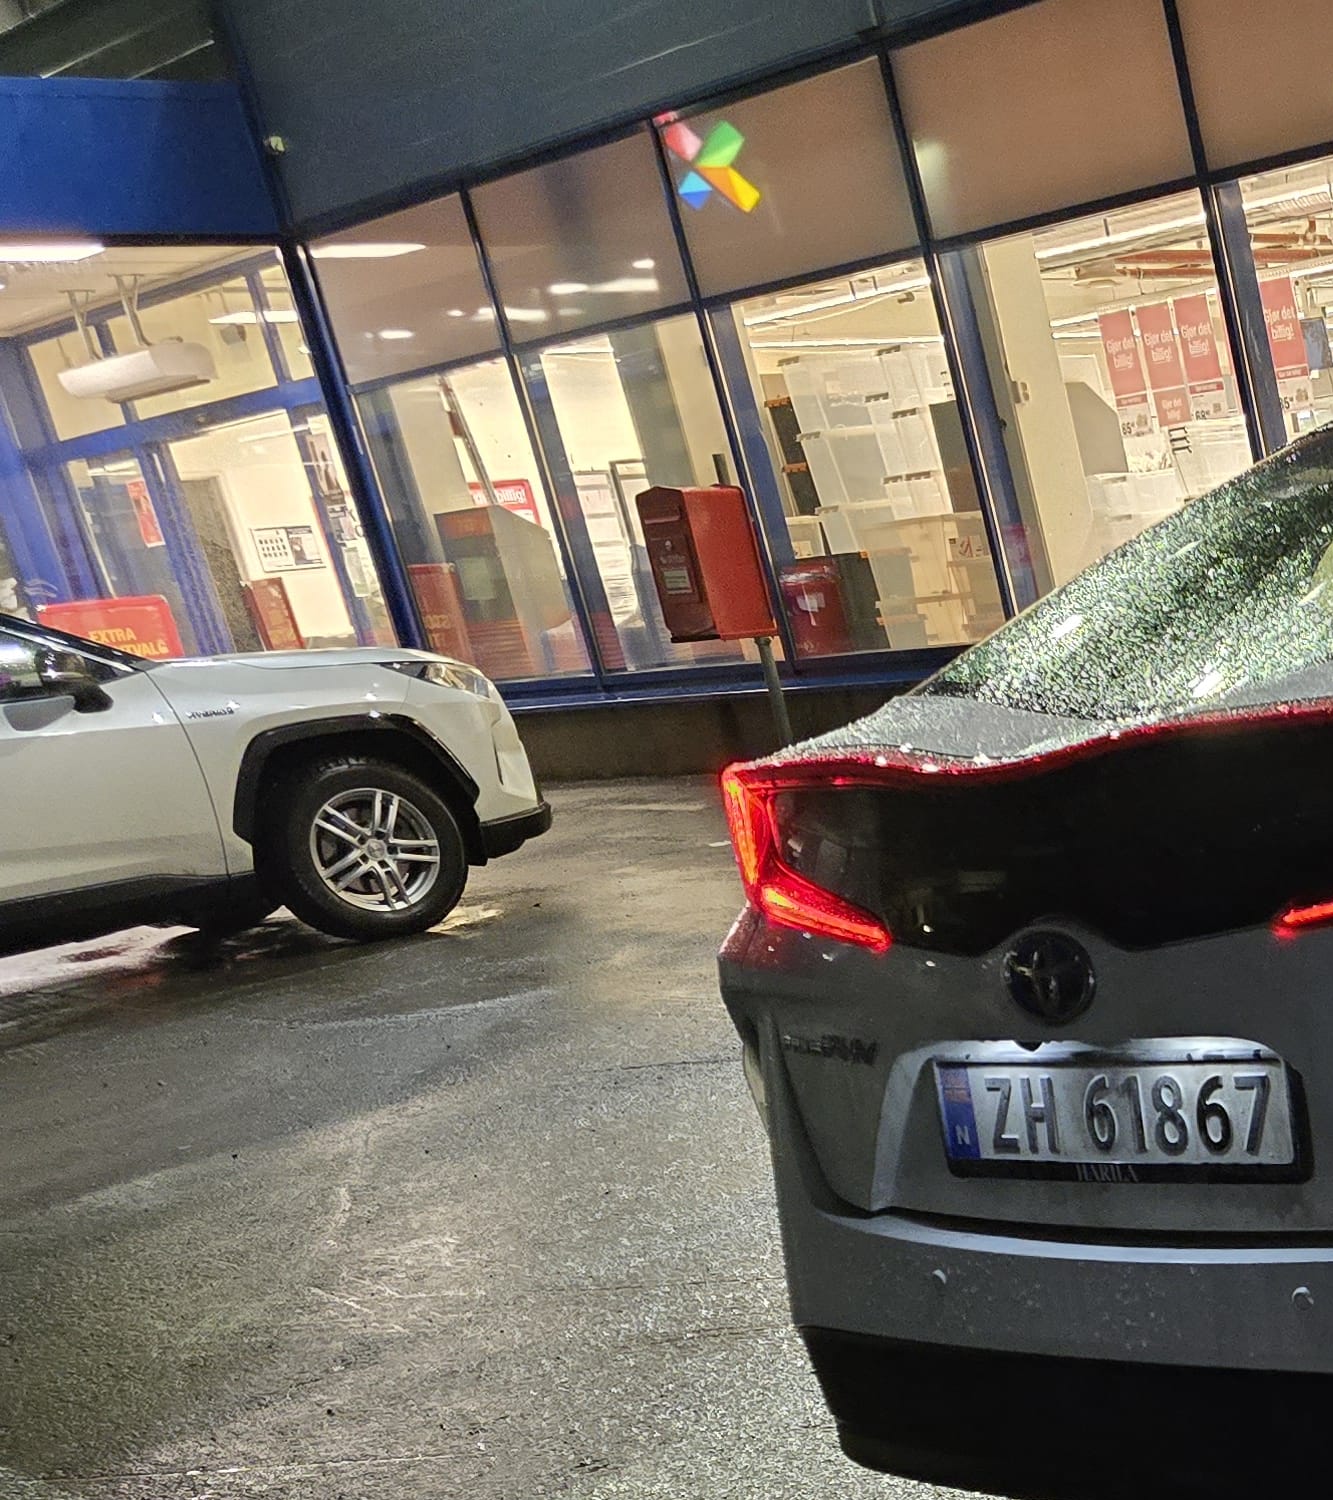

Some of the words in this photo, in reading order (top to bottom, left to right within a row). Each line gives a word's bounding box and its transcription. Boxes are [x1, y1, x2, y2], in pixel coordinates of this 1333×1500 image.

[88, 626, 138, 643] EXTRA
[956, 1125, 971, 1146] N
[984, 1075, 1061, 1156] ZH
[1084, 1073, 1271, 1157] 61867
